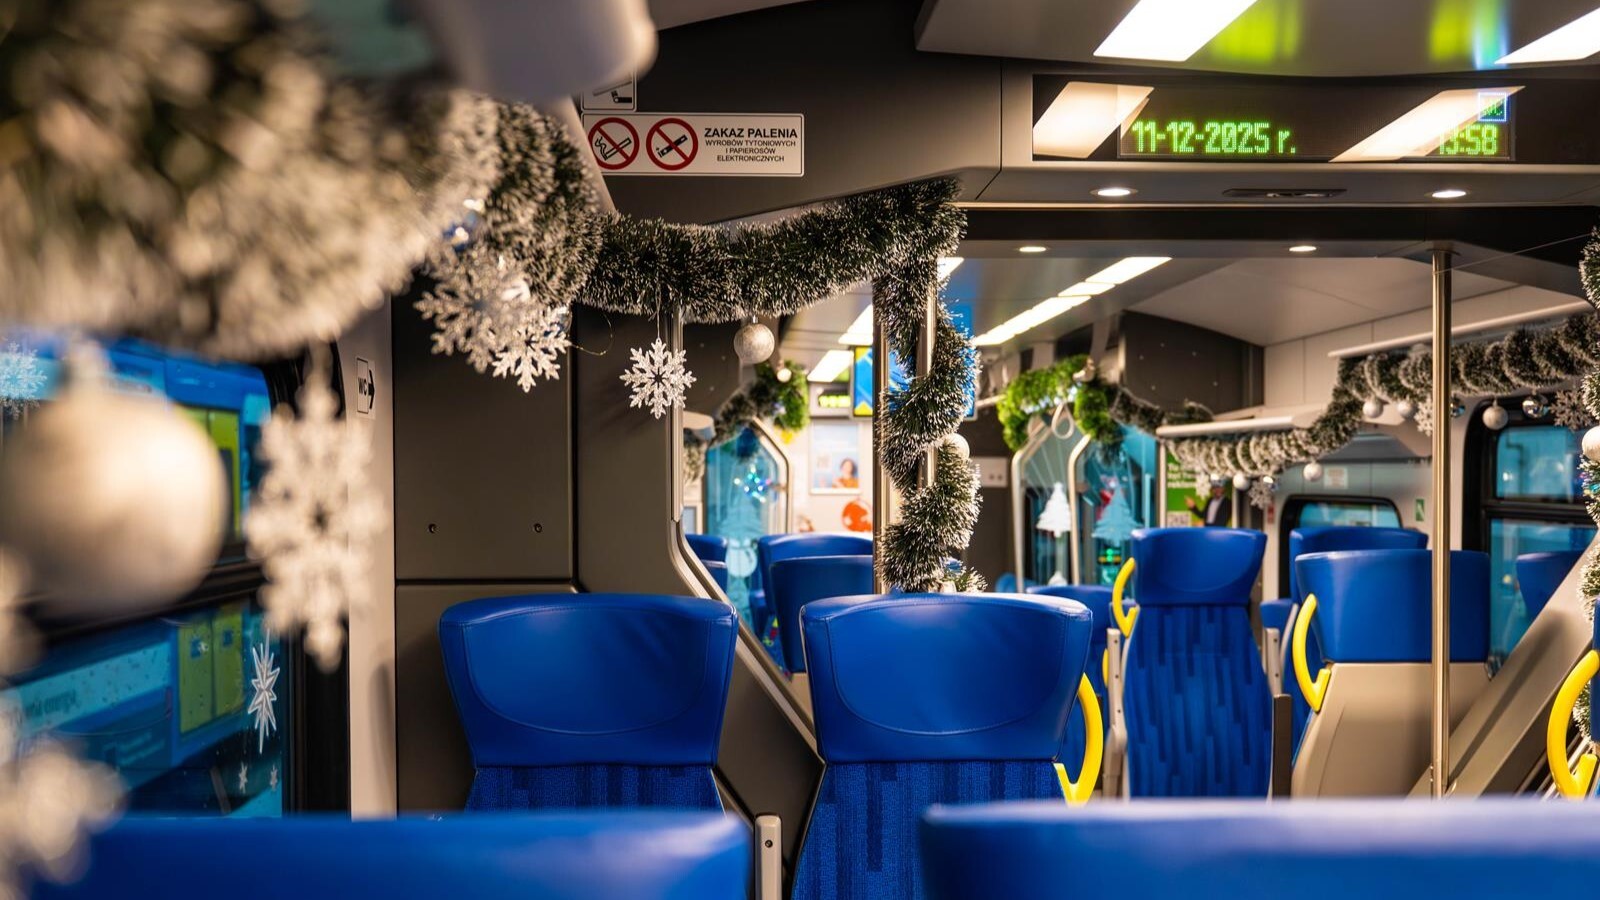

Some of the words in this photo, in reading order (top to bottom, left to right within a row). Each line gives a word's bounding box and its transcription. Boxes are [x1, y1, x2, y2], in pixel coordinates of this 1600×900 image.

[704, 127, 745, 138] ZAKAZ
[747, 128, 798, 138] PALENIA
[1132, 121, 1270, 153] 11-12-2025
[1278, 130, 1297, 154] r.
[705, 139, 744, 147] WYROBÓW
